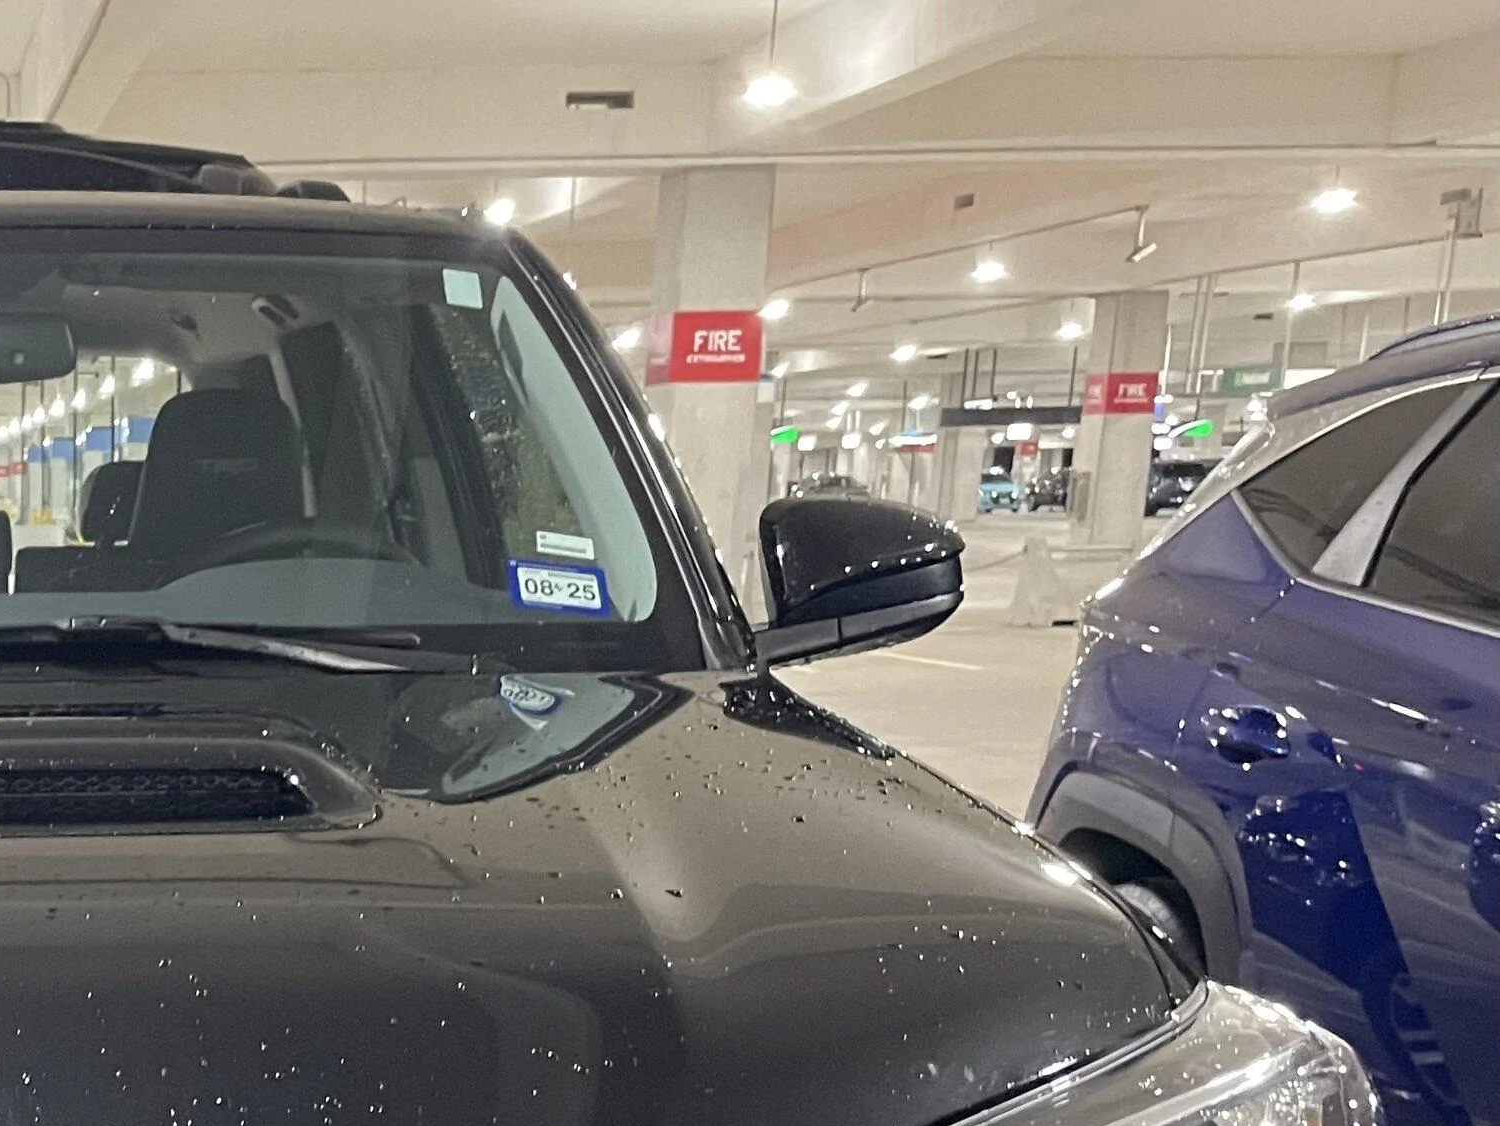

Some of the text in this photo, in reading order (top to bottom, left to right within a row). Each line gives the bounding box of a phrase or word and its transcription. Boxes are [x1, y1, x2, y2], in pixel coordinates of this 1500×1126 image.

[692, 329, 742, 353] FIRE
[524, 577, 554, 597] 08
[566, 582, 597, 601] 25
